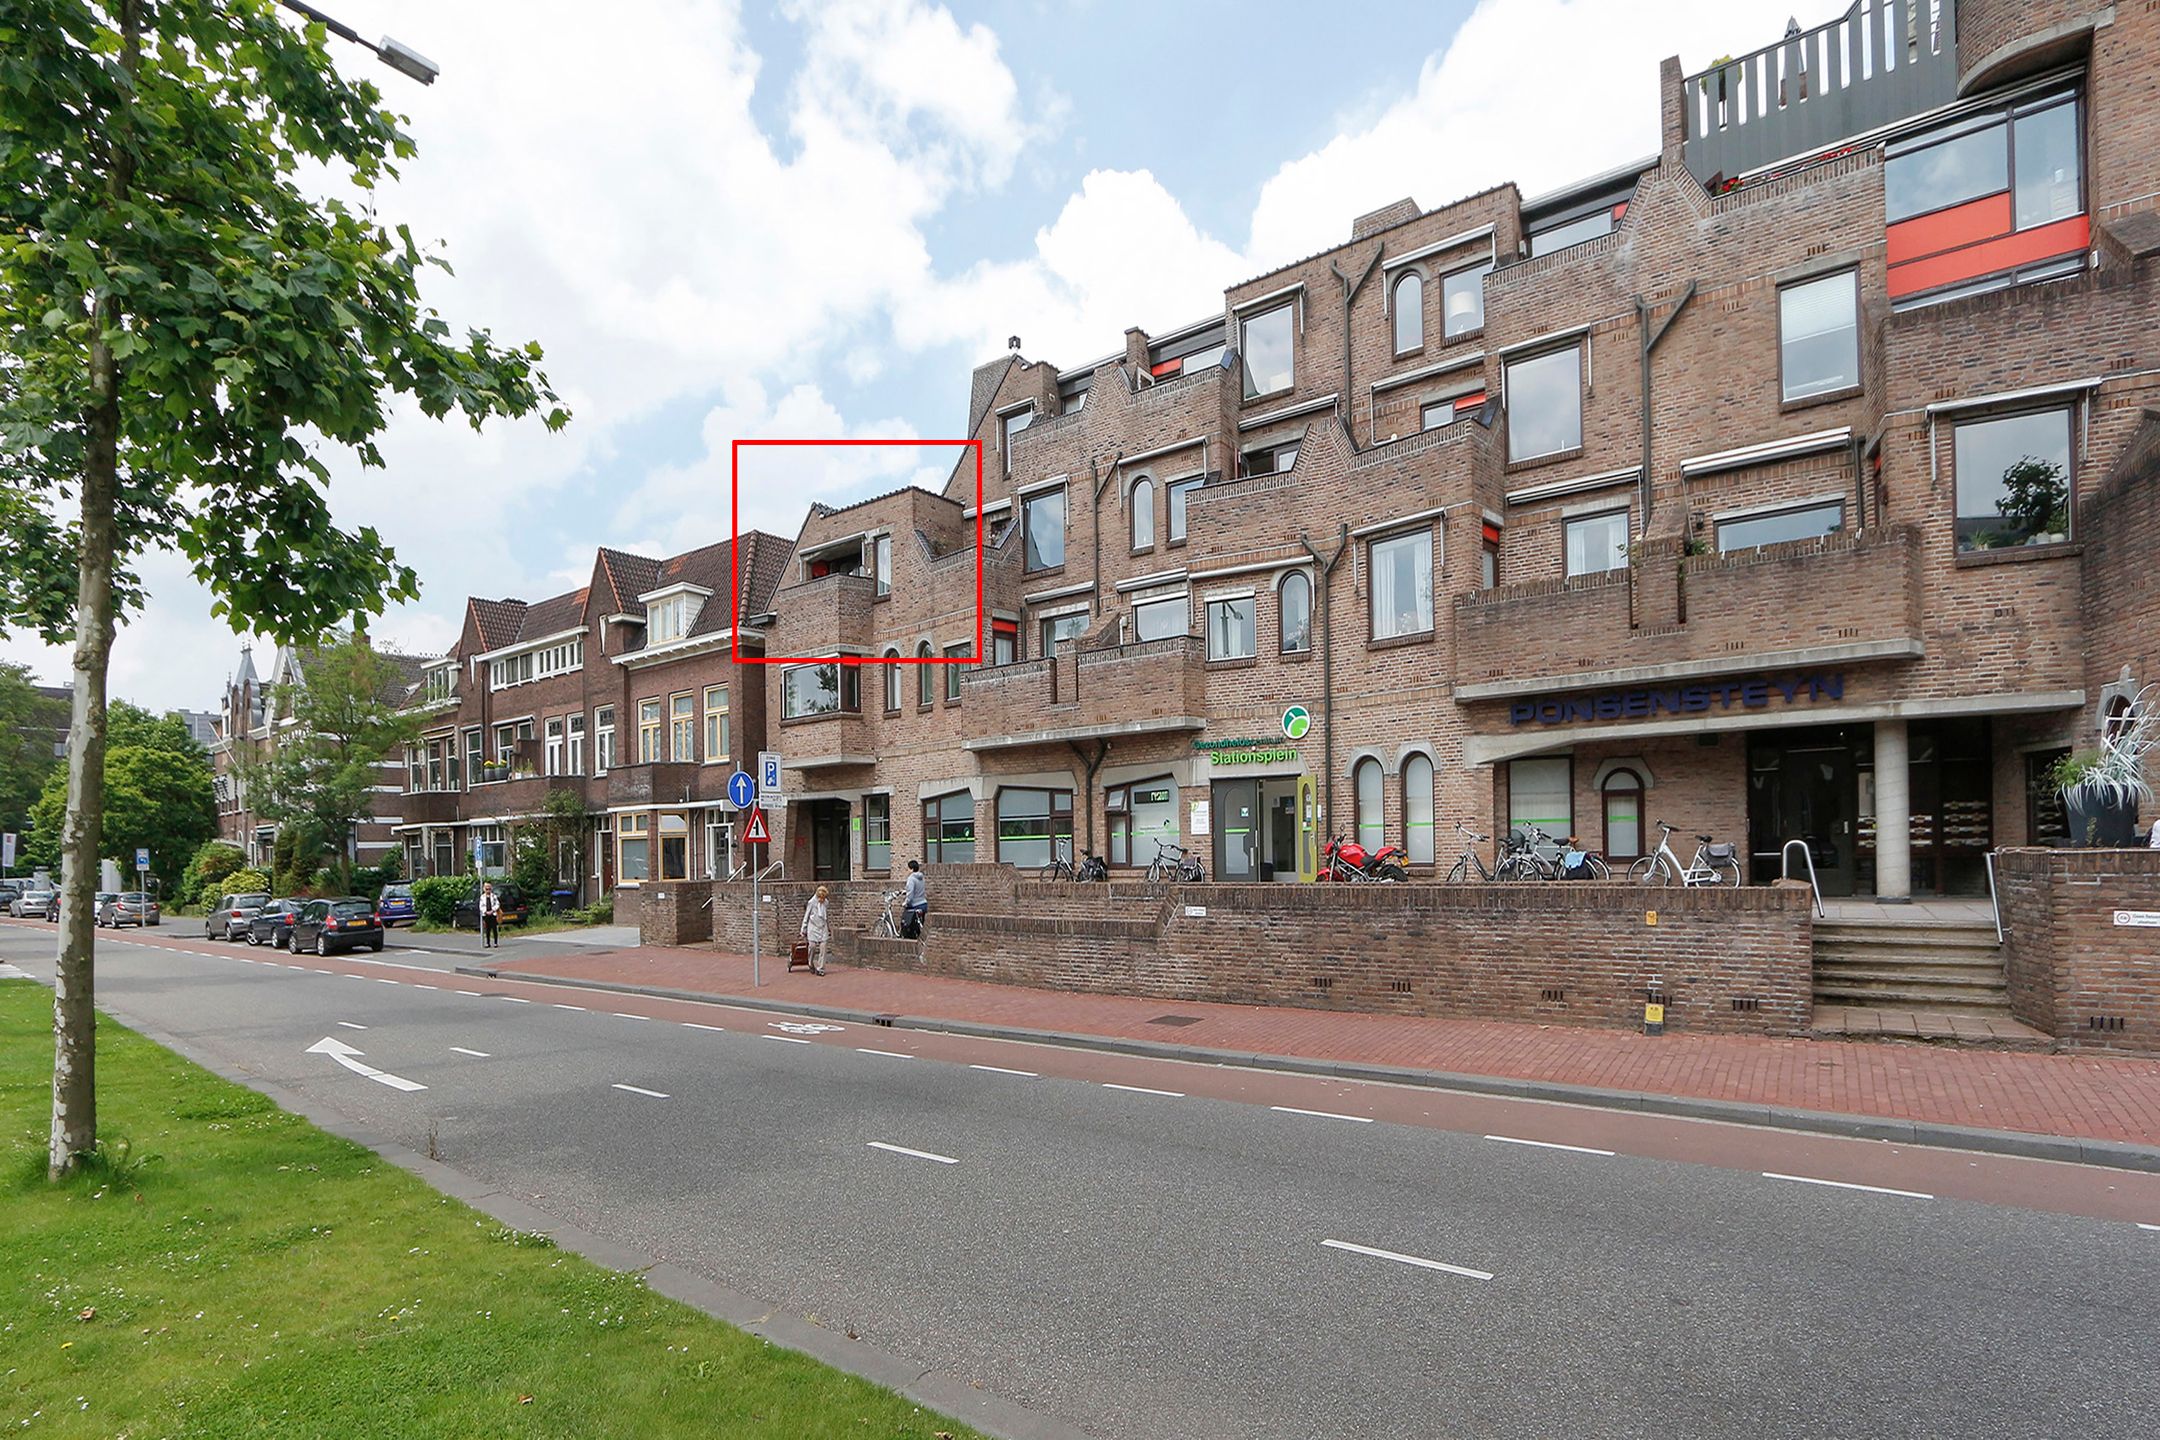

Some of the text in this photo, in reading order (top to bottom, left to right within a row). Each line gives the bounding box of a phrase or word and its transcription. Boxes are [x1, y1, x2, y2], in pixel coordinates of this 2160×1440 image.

[1509, 675, 1845, 726] PONSENSTEYN
[1210, 748, 1298, 765] Stationsplein
[767, 763, 775, 776] P
